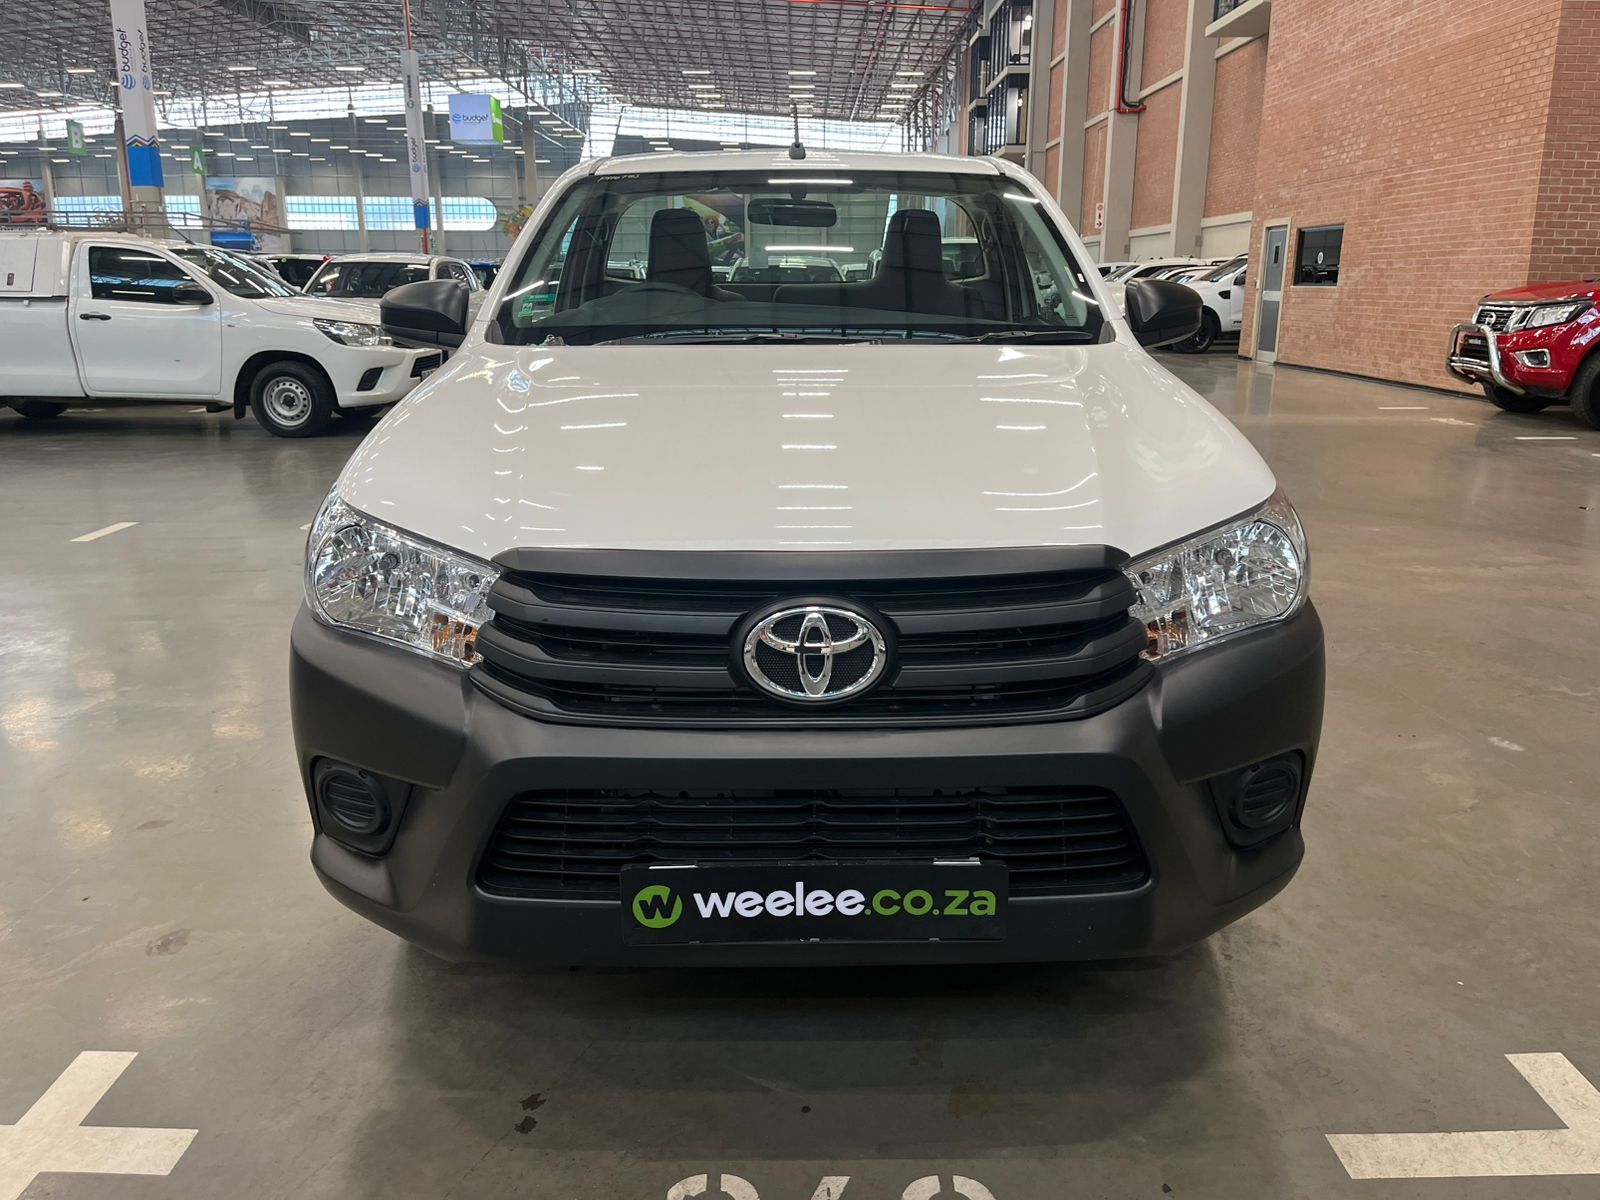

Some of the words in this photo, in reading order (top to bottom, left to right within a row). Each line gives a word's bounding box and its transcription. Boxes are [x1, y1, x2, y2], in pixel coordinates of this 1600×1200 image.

[116, 27, 132, 72] budget
[137, 29, 148, 73] budget
[462, 113, 488, 124] budget
[70, 126, 83, 149] B
[193, 150, 203, 170] A
[693, 881, 997, 919] weelee.co.za
